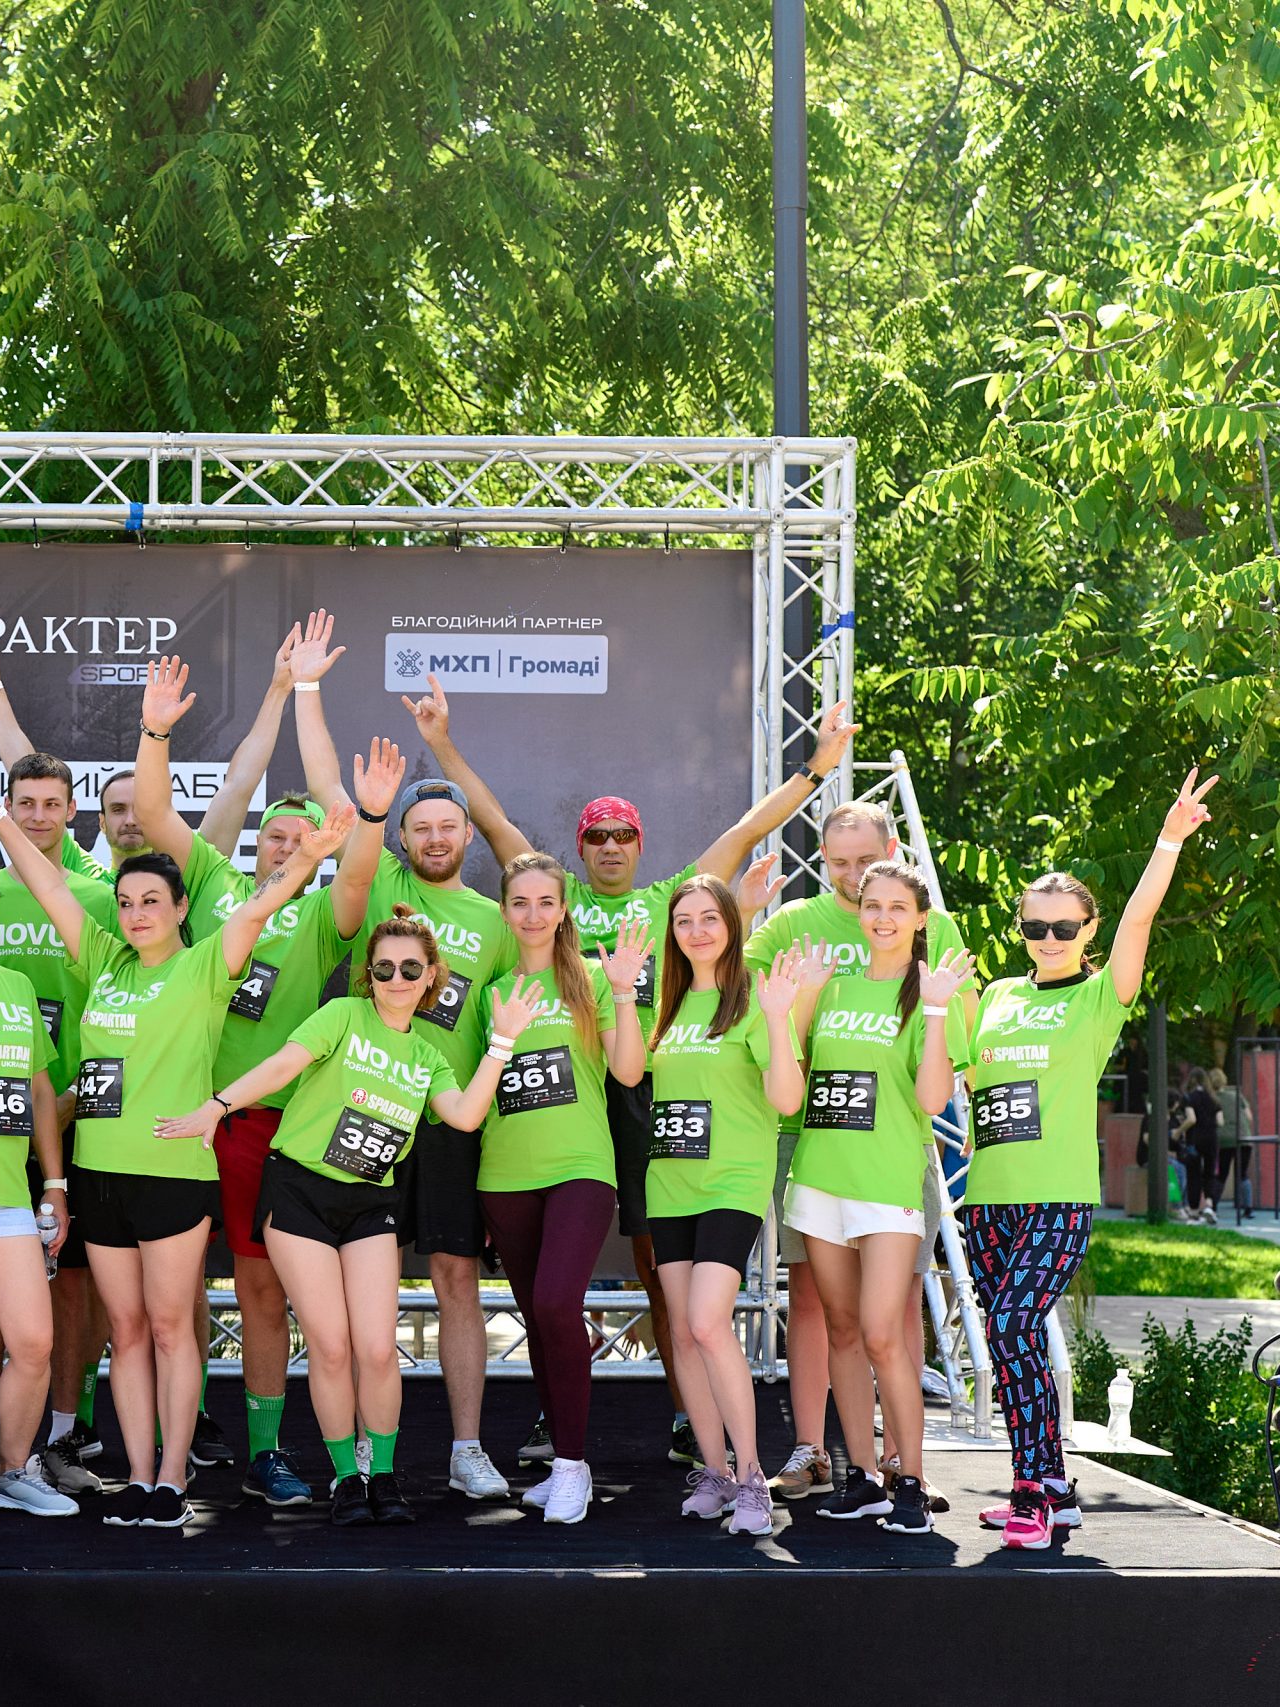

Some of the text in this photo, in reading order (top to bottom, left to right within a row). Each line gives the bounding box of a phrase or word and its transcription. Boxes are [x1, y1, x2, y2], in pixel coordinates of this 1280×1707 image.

[391, 615, 603, 629] БЛАГОДІЙНИЙ ПАРТНЕР
[429, 655, 600, 677] МХП Громаді
[572, 899, 650, 929] NOVUS
[407, 913, 482, 953] OVUS
[27, 947, 40, 955] БО
[437, 943, 478, 964] ЛЮБИМО
[89, 1010, 137, 1029] SPARTAN
[534, 1017, 577, 1028] ЛЮБИМО
[817, 1010, 903, 1037] NOVUS
[107, 1029, 136, 1037] UKRAINE
[660, 1023, 724, 1045] OVUS
[853, 1033, 894, 1047] ЛЮБИМО
[347, 1033, 432, 1089] NOVUS
[681, 1046, 720, 1055] ЛЮБИМО
[994, 1045, 1049, 1062] SPARTAN
[1, 1061, 29, 1070] UKRAINE
[343, 1059, 385, 1082] РОБИМО,
[80, 1075, 115, 1097] 347
[502, 1064, 560, 1093] 361
[812, 1087, 868, 1108] 352
[367, 1094, 418, 1125] SPARTAN
[977, 1098, 1032, 1127] 335
[383, 1116, 412, 1132] UKRAINE
[654, 1117, 705, 1138] 333
[339, 1127, 397, 1163] 358
